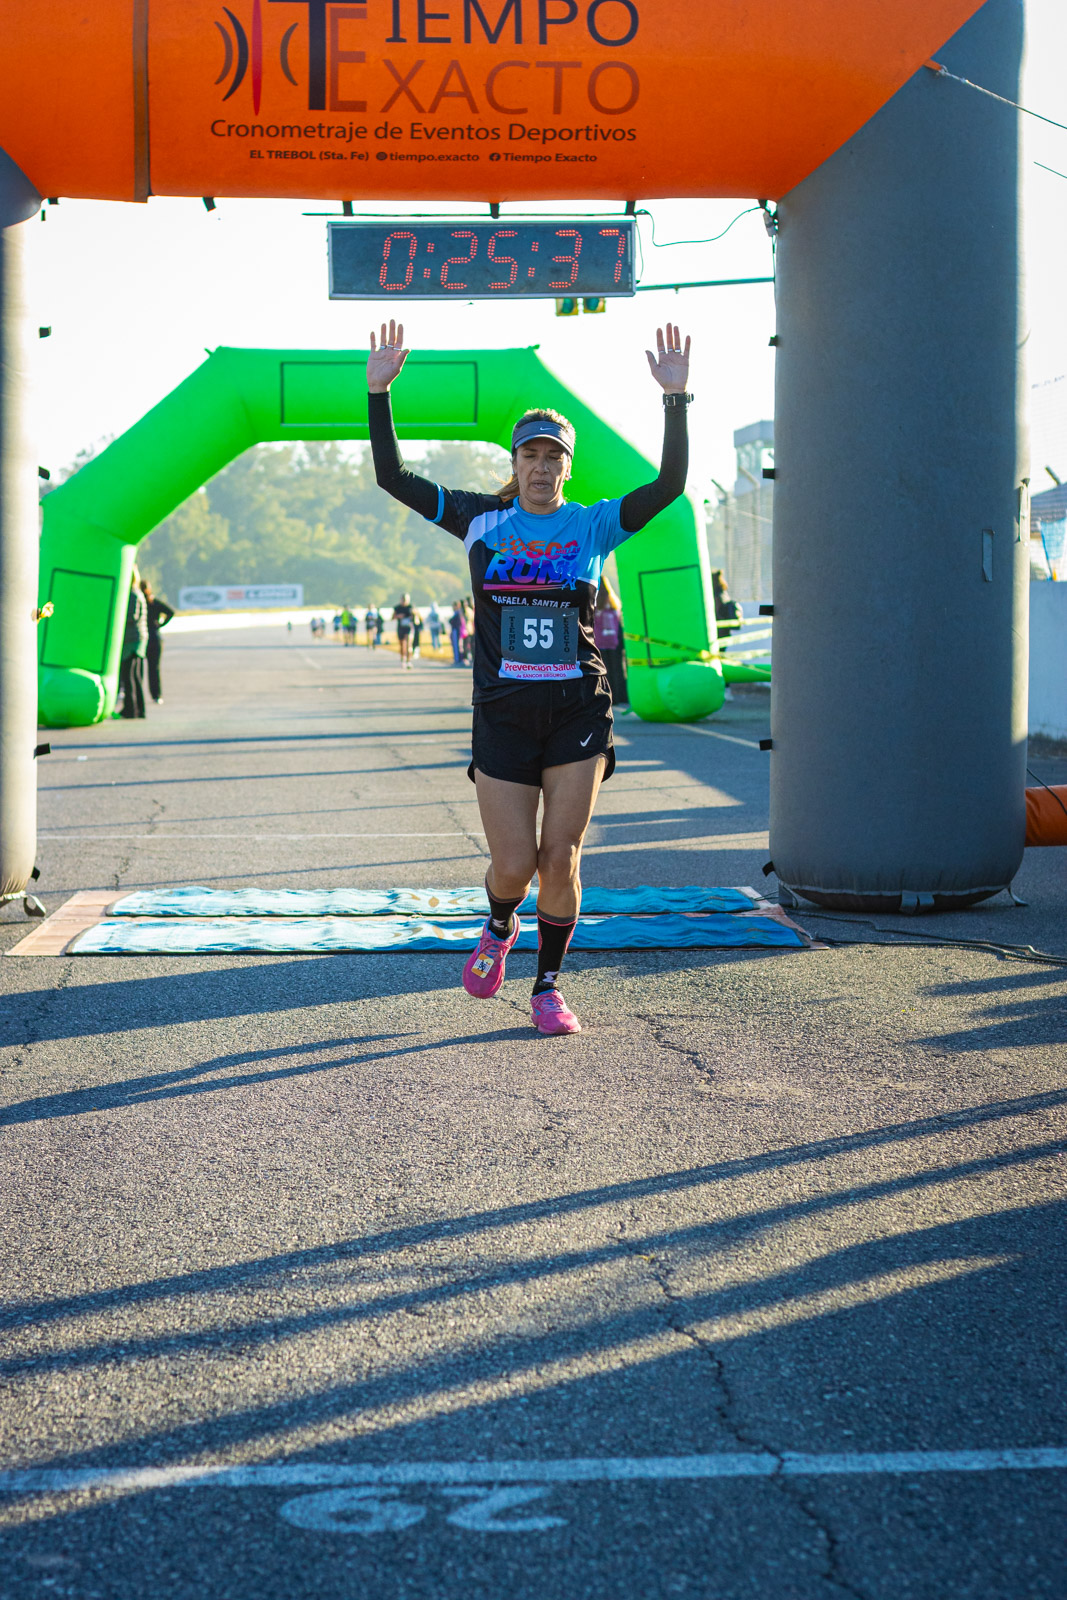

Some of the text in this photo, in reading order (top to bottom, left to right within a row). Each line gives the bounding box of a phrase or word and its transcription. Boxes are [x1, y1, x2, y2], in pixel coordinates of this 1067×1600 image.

[210, 119, 637, 144] Cronometraje de Eventos Deportivos
[250, 151, 598, 163] EL TREBOL (Sta. Fe) tiempo.exacto Tiempo Exacto
[379, 229, 626, 290] 0:25:37
[492, 594, 530, 606] RAFAELA,
[532, 598, 559, 608] SANTA
[523, 618, 554, 649] 55
